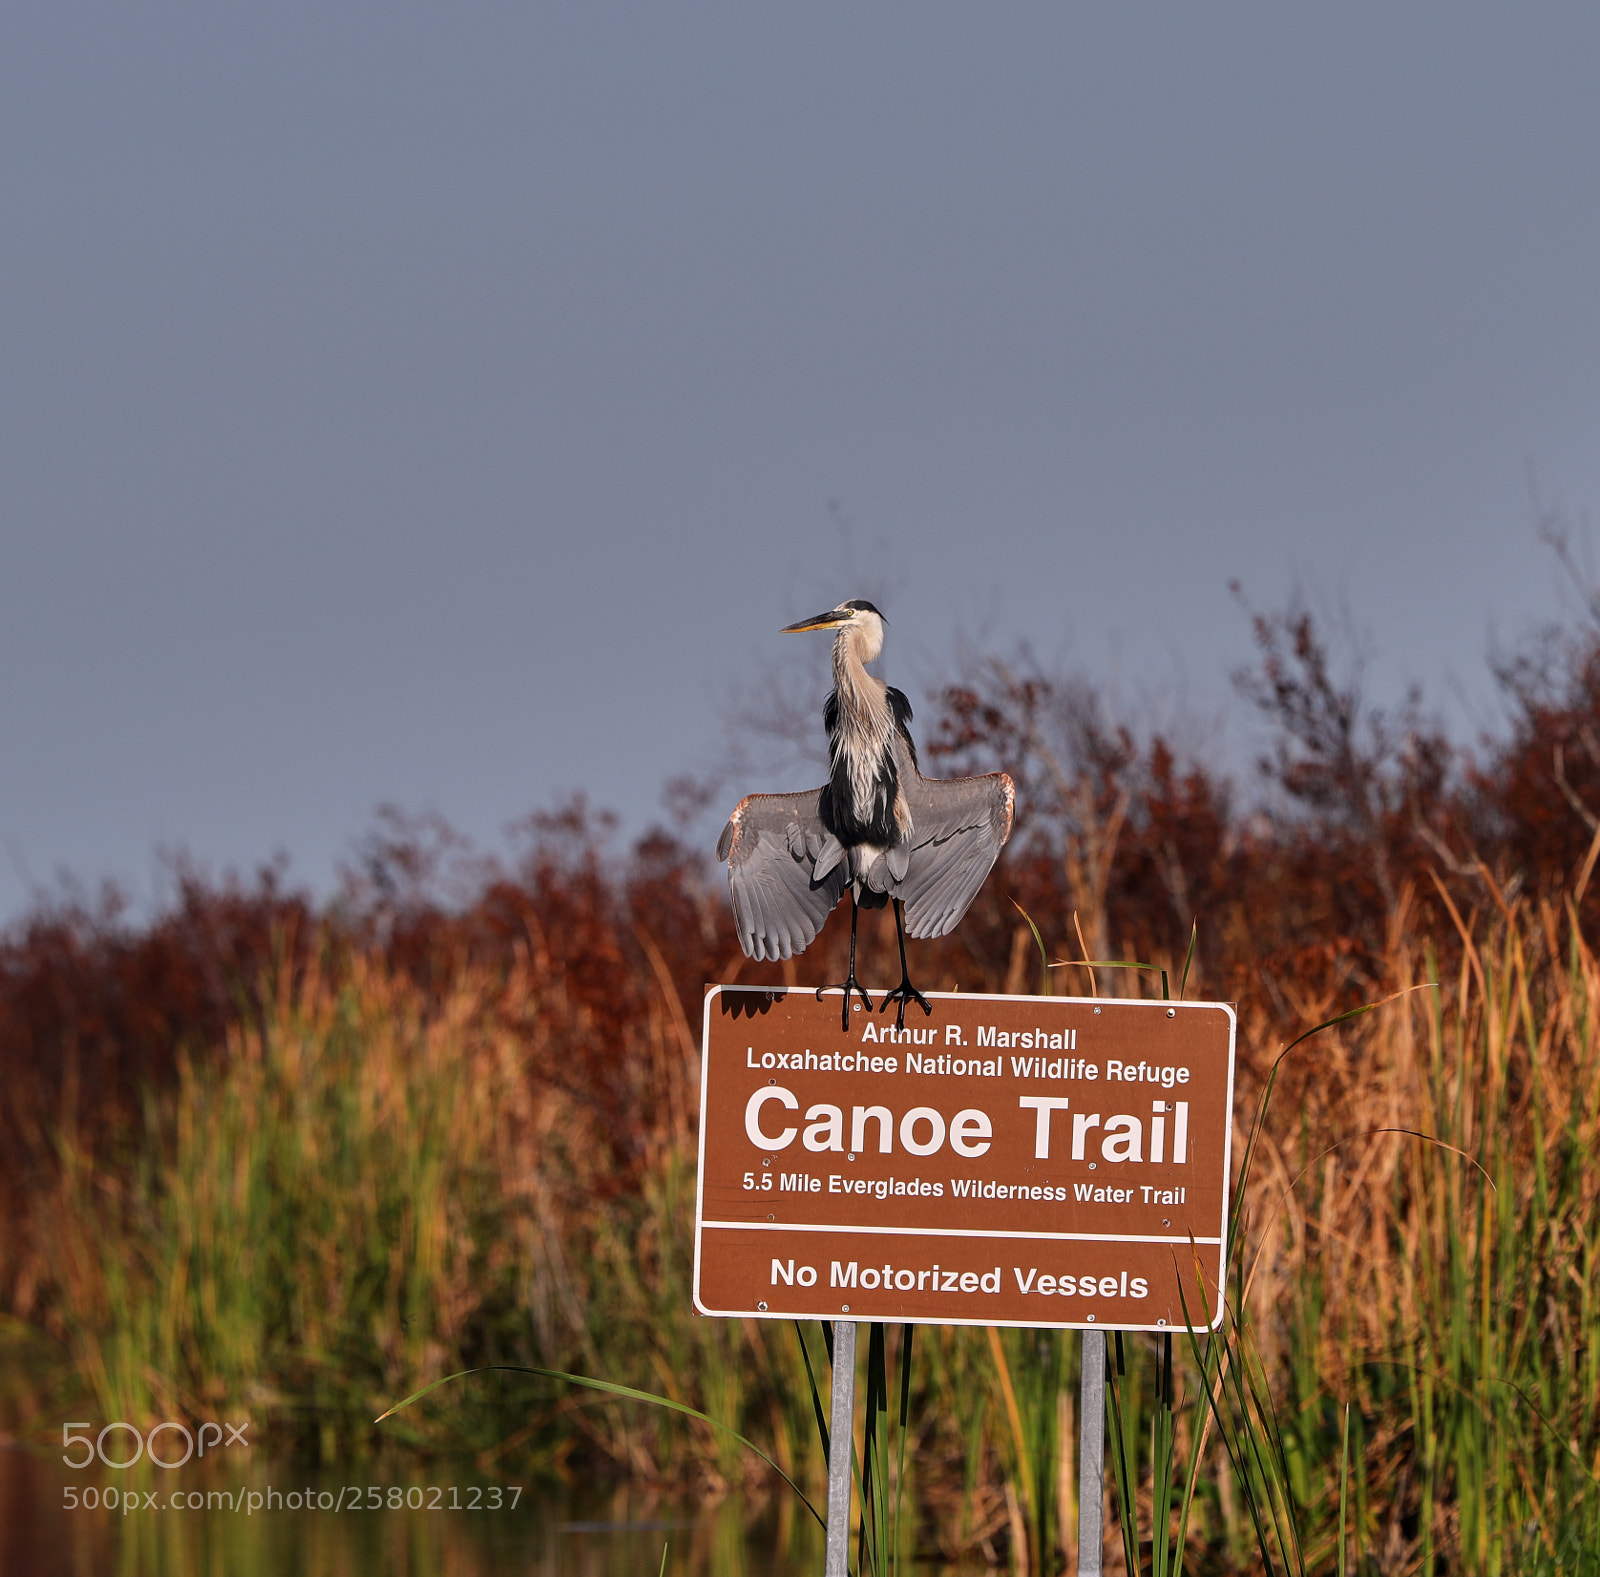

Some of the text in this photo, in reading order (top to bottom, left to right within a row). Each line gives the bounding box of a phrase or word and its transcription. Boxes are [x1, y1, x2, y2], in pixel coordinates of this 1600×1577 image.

[861, 1021, 1077, 1050] Arthur R. Marshall
[746, 1046, 1190, 1089] Loxahatchee National Wildlife Refuge
[744, 1085, 1189, 1164] Canoe Trail
[742, 1172, 1186, 1205] 5.5 Mile Everglades Wilderness Water Trail
[770, 1258, 1149, 1299] No Motorized Vessels
